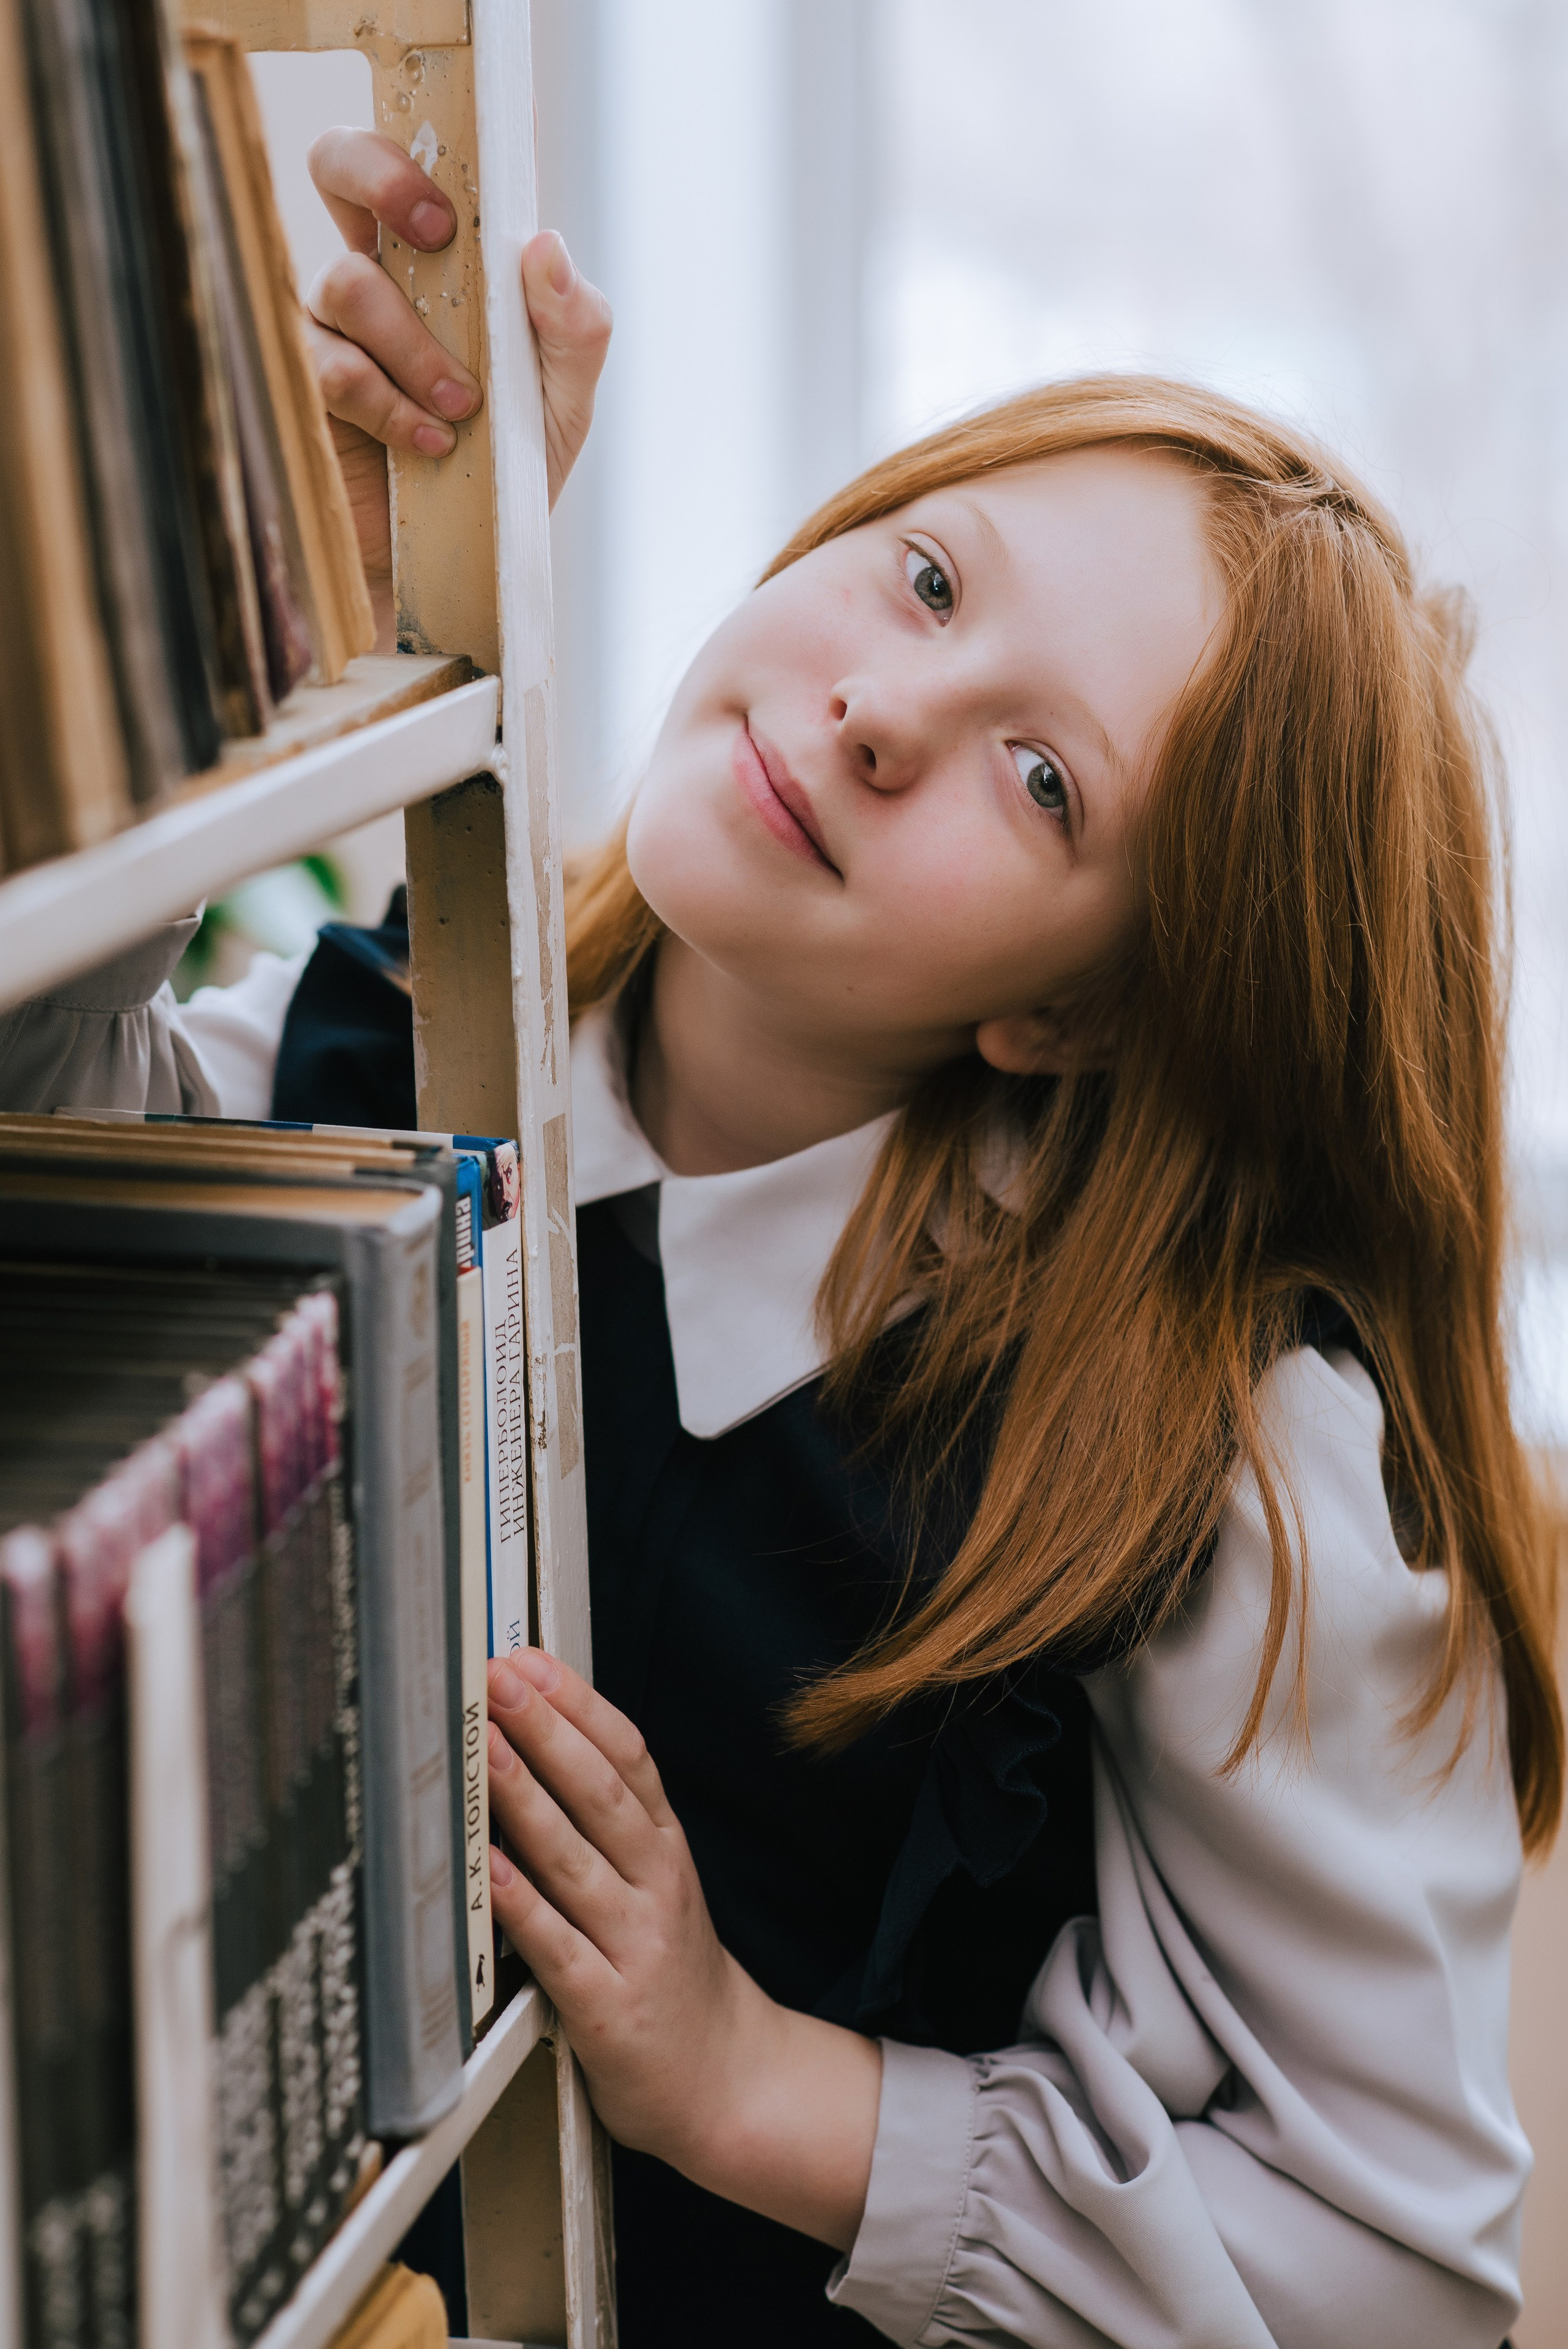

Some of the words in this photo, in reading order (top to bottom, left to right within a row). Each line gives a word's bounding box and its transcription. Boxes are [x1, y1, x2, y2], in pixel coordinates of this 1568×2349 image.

[507, 1247, 520, 1362] ГАРИНА
[495, 1319, 511, 1544] ГИПЕРБОЛОИД
[509, 1369, 524, 1535] ИНЖЕНЕРА
[462, 1702, 480, 1845] ТОЛСТОЙ
